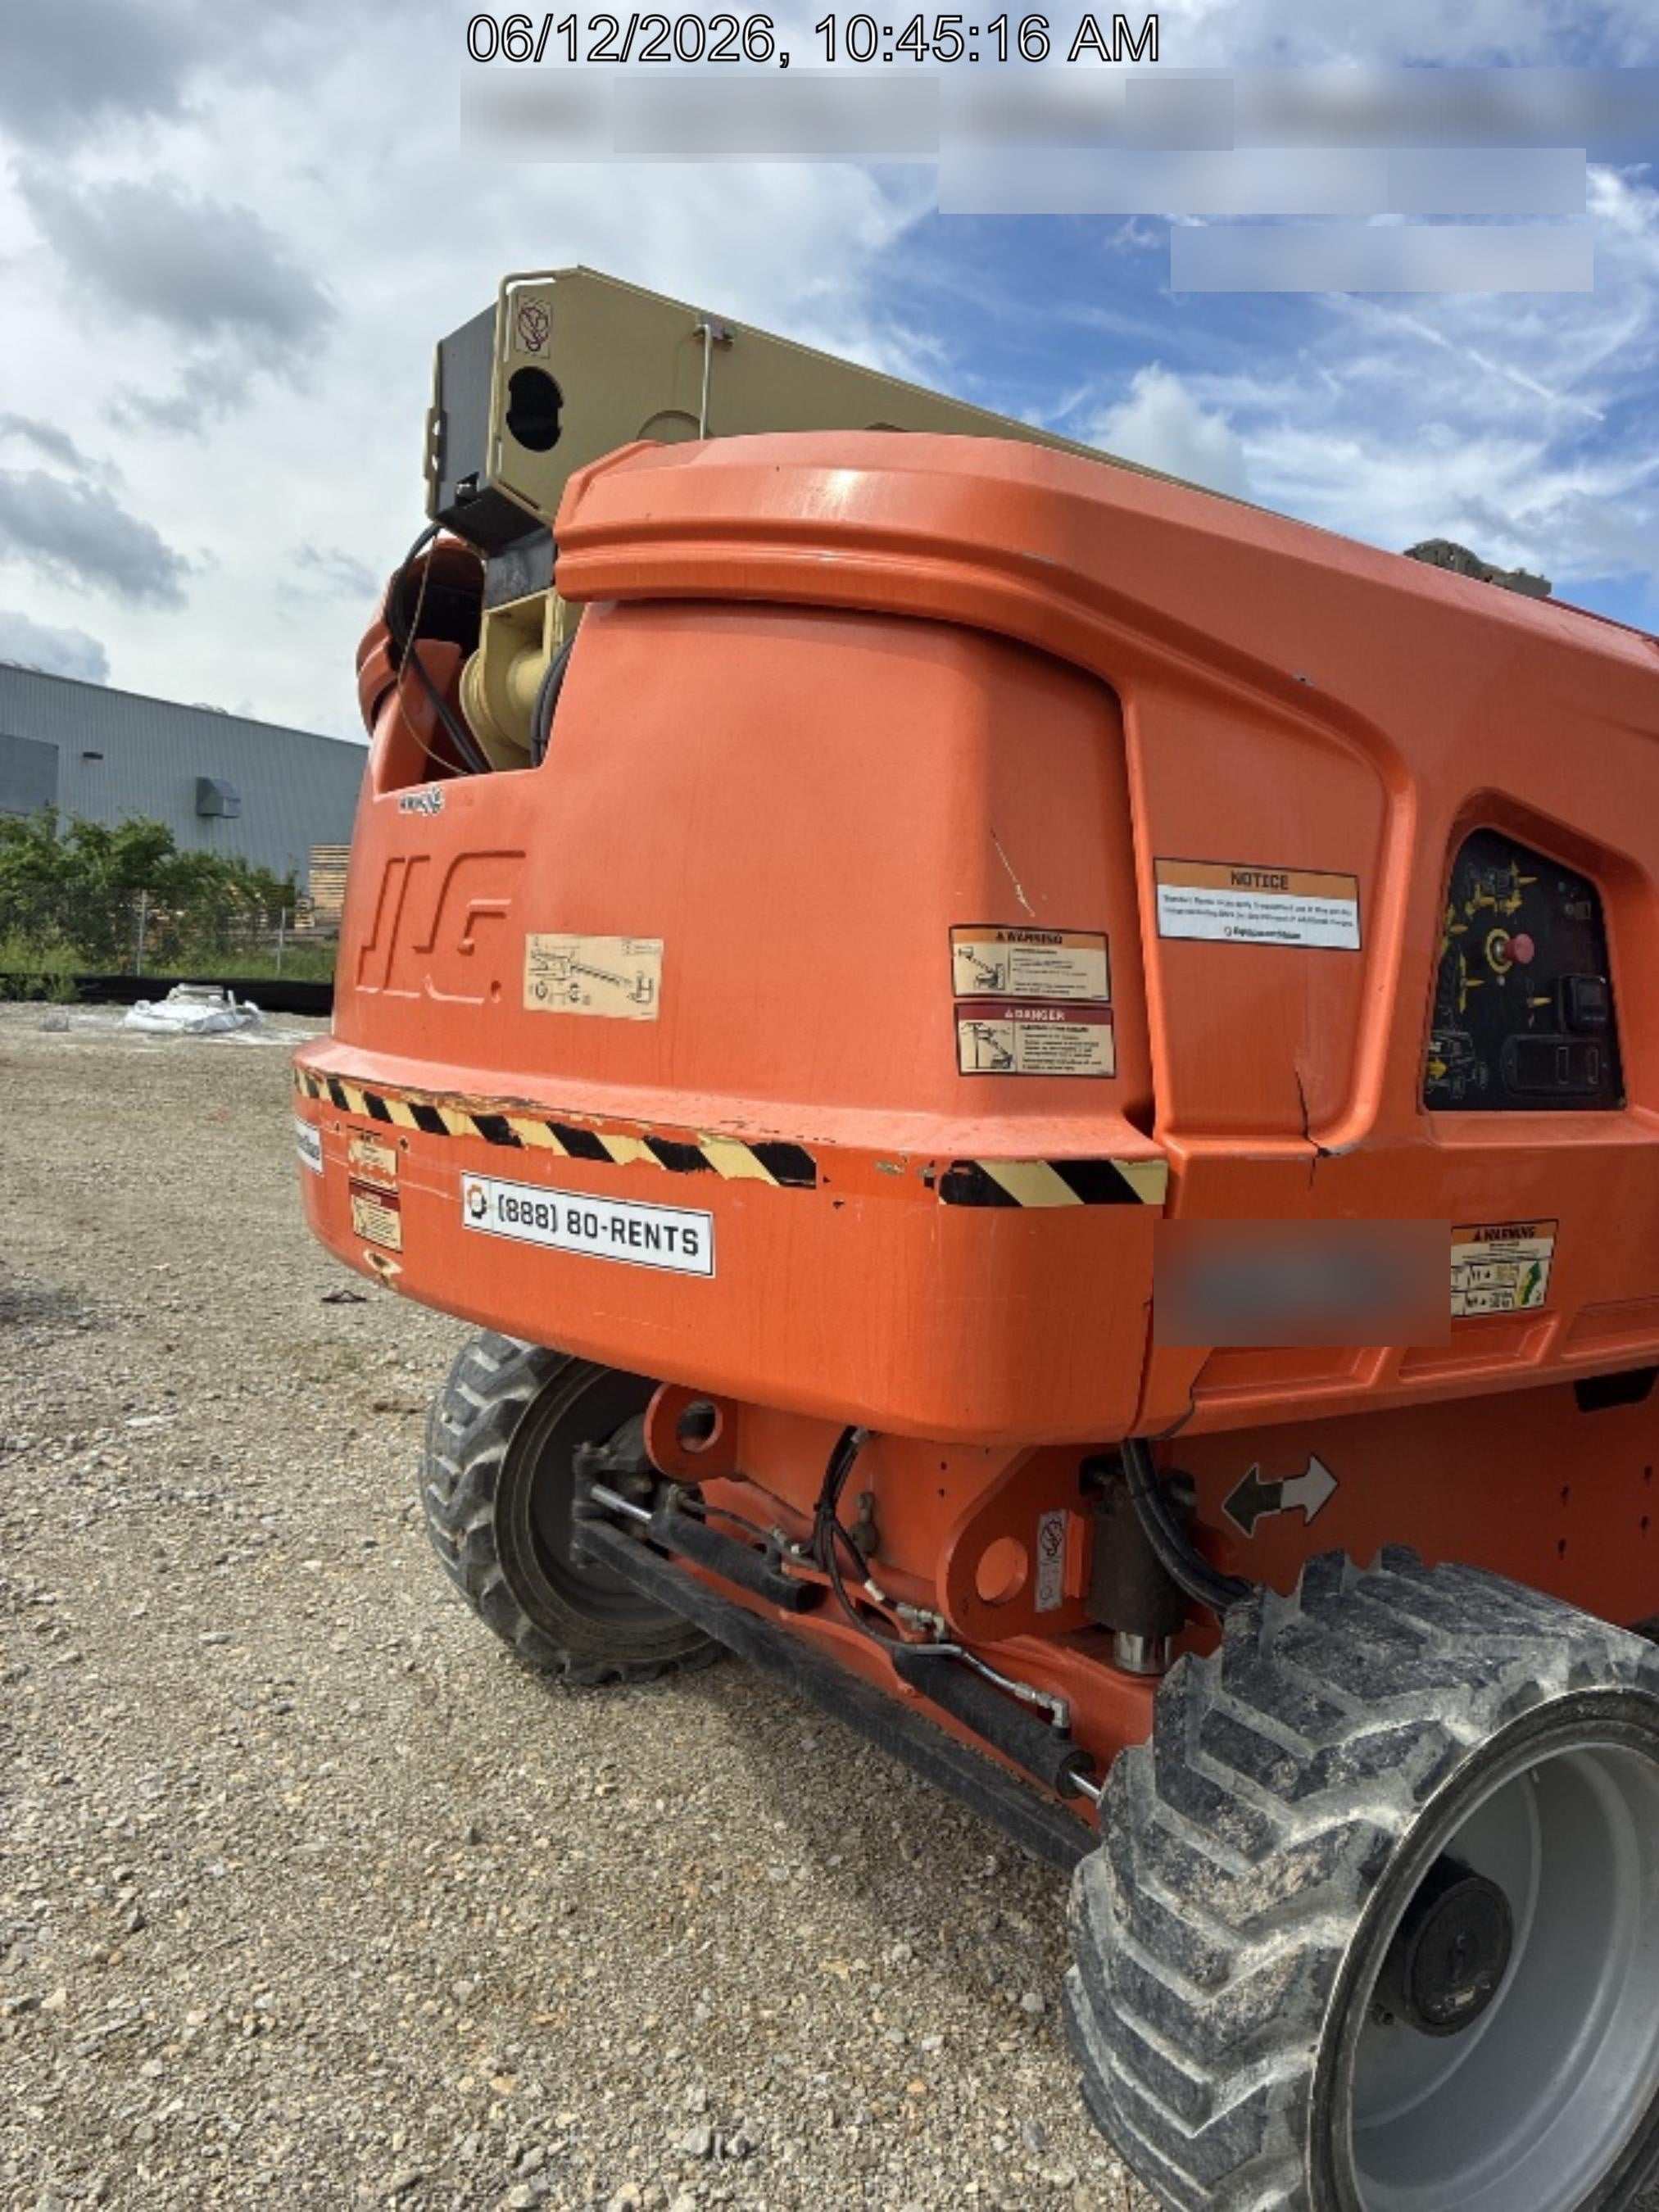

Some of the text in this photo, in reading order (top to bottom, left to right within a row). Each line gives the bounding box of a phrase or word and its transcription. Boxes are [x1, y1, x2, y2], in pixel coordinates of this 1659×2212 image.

[1231, 871, 1289, 891] NOTICE
[1014, 1009, 1066, 1022] DANGER
[497, 1194, 700, 1257] (888) 80-RENTS
